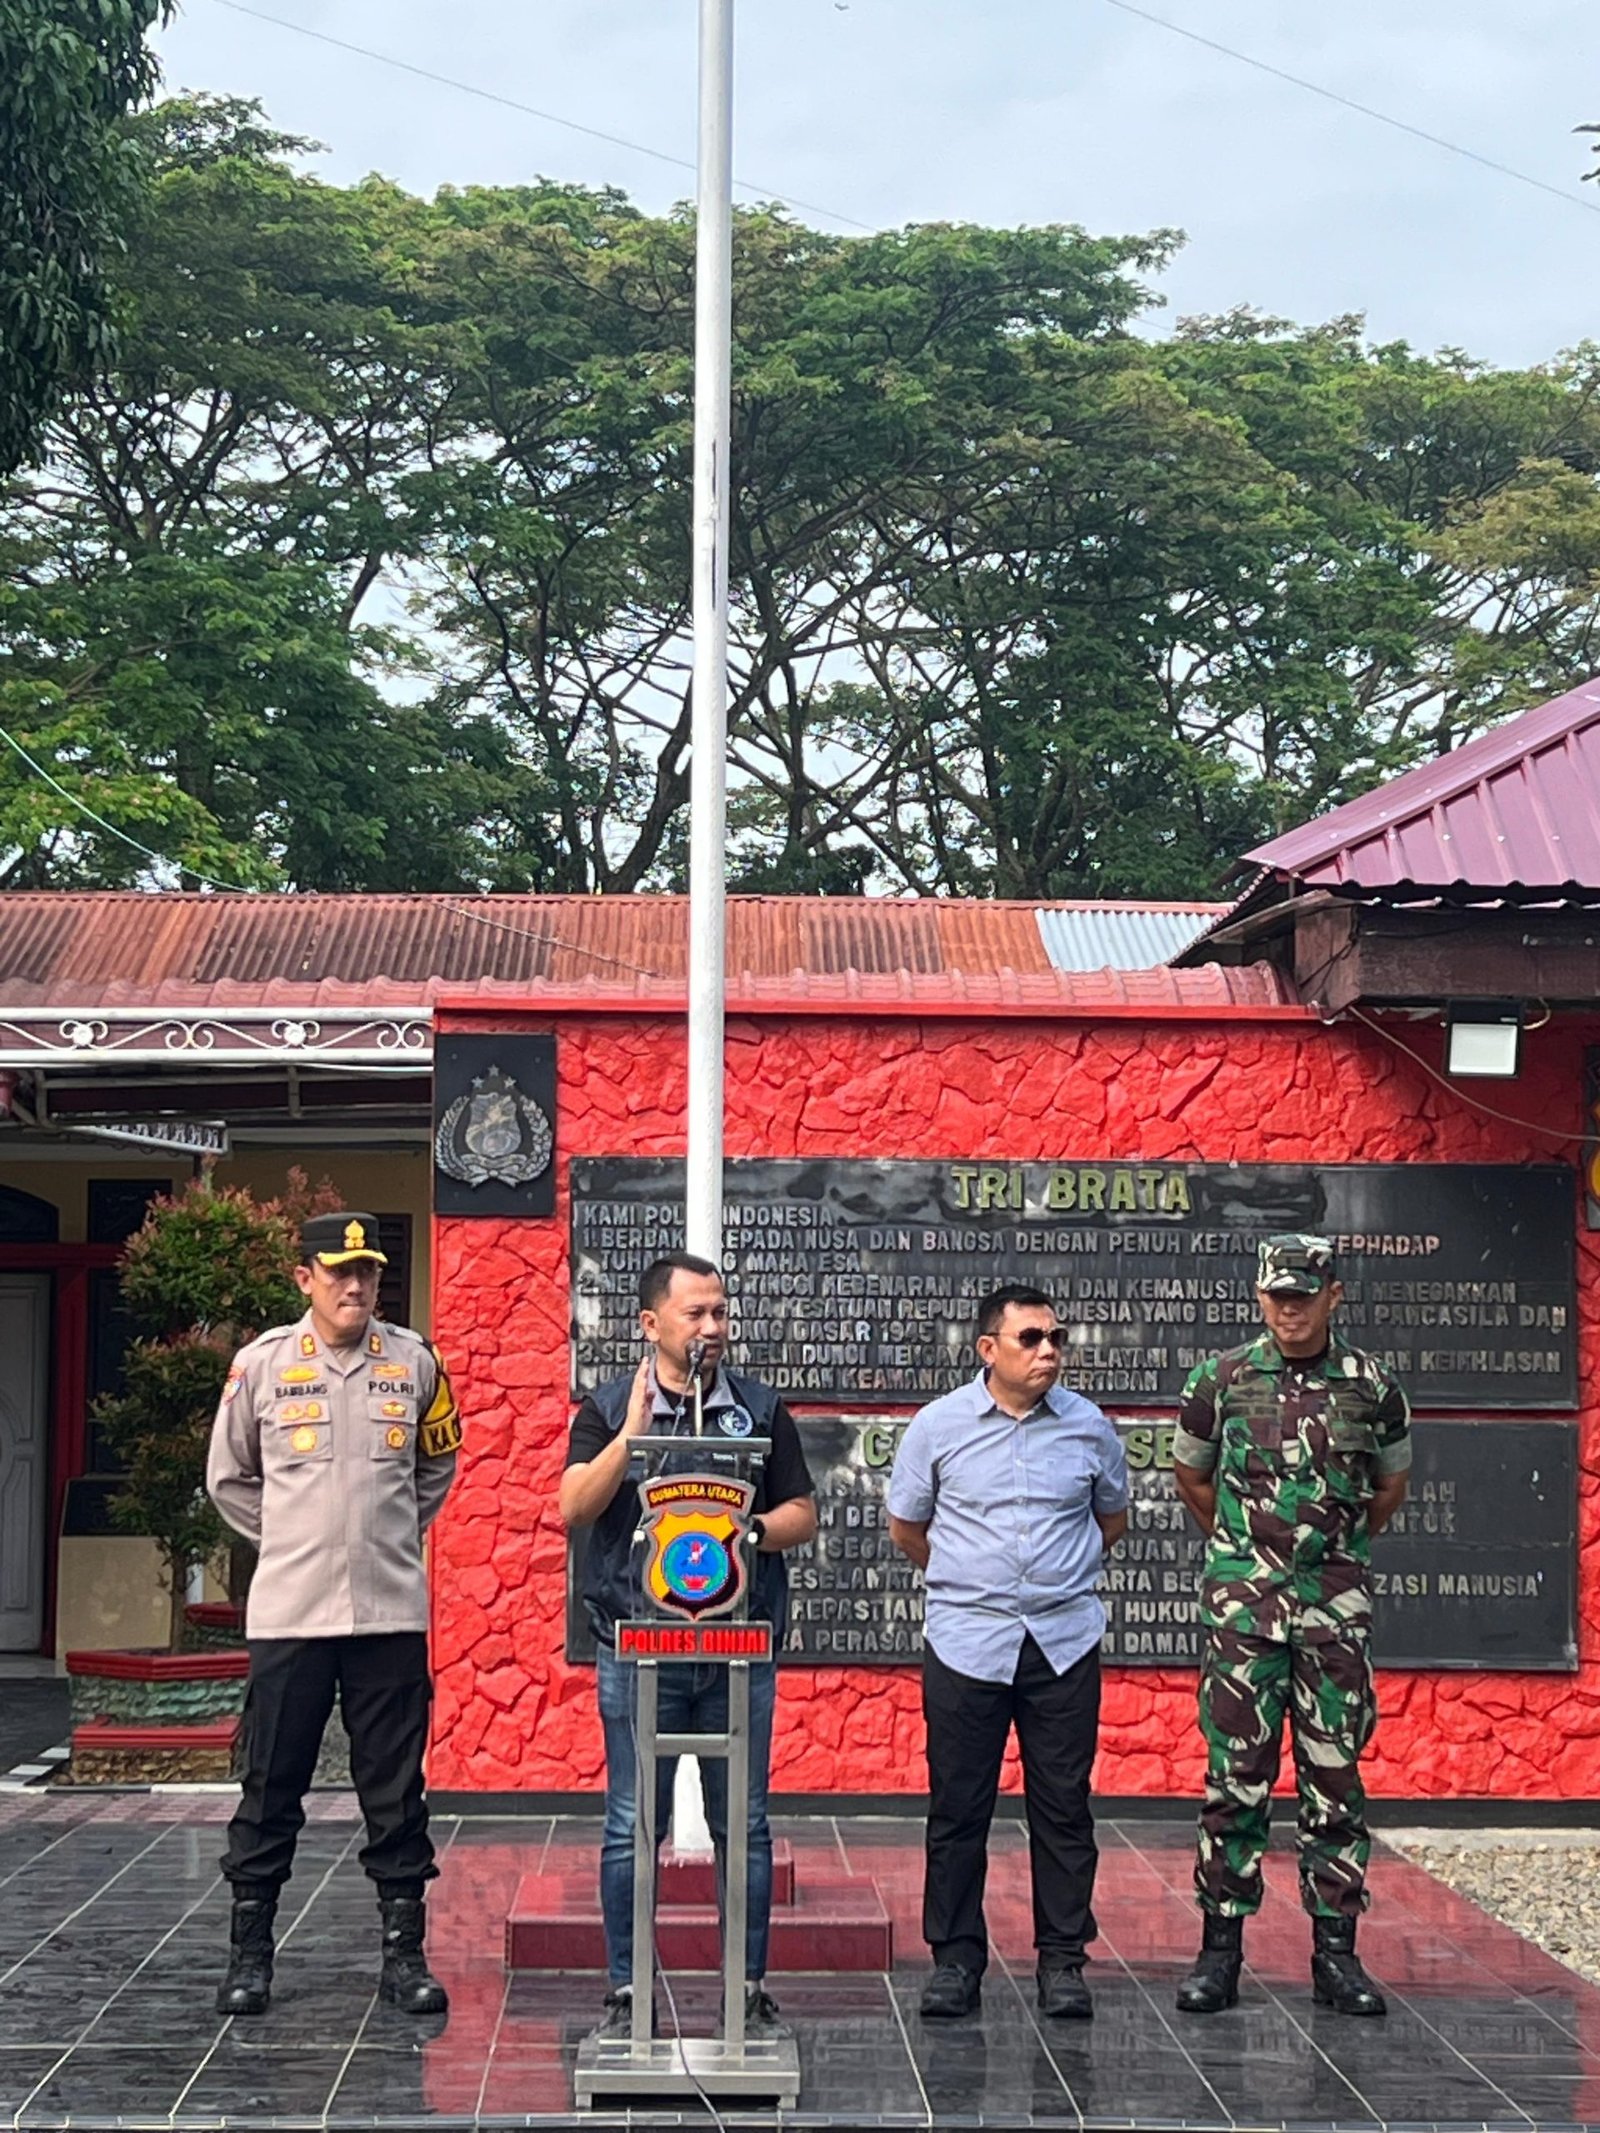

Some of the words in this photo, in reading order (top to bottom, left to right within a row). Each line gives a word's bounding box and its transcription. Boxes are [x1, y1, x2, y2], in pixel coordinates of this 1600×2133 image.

[951, 1166, 1023, 1209] TRI
[1049, 1168, 1191, 1211] BRATA
[583, 1205, 635, 1226] KAMI
[645, 1205, 686, 1226] POL
[723, 1205, 833, 1227] INDONESIA
[601, 1228, 687, 1249] BERBAK
[722, 1229, 794, 1250] EPADA
[804, 1229, 859, 1250] NUSA
[869, 1230, 911, 1251] DAN
[923, 1230, 1005, 1252] BANGSA
[1015, 1231, 1098, 1252] DENGAN
[1109, 1232, 1181, 1253] PENUH
[746, 1251, 809, 1272] MAHA
[818, 1252, 862, 1272] ESA
[747, 1273, 815, 1295] TINGGI
[822, 1274, 952, 1297] KEBENARAN
[1078, 1278, 1119, 1299] DAN
[1126, 1278, 1257, 1301] KEMANUSIA
[1372, 1281, 1517, 1303] MENEGAKKAN
[781, 1296, 892, 1319] KESATUAN
[1143, 1302, 1197, 1323] YANG
[1374, 1304, 1510, 1327] PANCASILA
[1519, 1305, 1567, 1328] DAN
[793, 1320, 872, 1342] DASAR
[881, 1320, 935, 1344] 1945
[877, 1344, 982, 1367] MENGAYO
[275, 1383, 328, 1399] BAMBANG
[368, 1380, 415, 1395] POLRI
[649, 1484, 706, 1504] SUMATERA
[706, 1484, 743, 1505] UTARA
[1093, 1569, 1152, 1592] ARTA
[1373, 1574, 1428, 1595] ZASI
[1438, 1574, 1538, 1596] MANUSIA
[621, 1628, 696, 1654] POLRES
[1124, 1632, 1199, 1654] DAMAI
